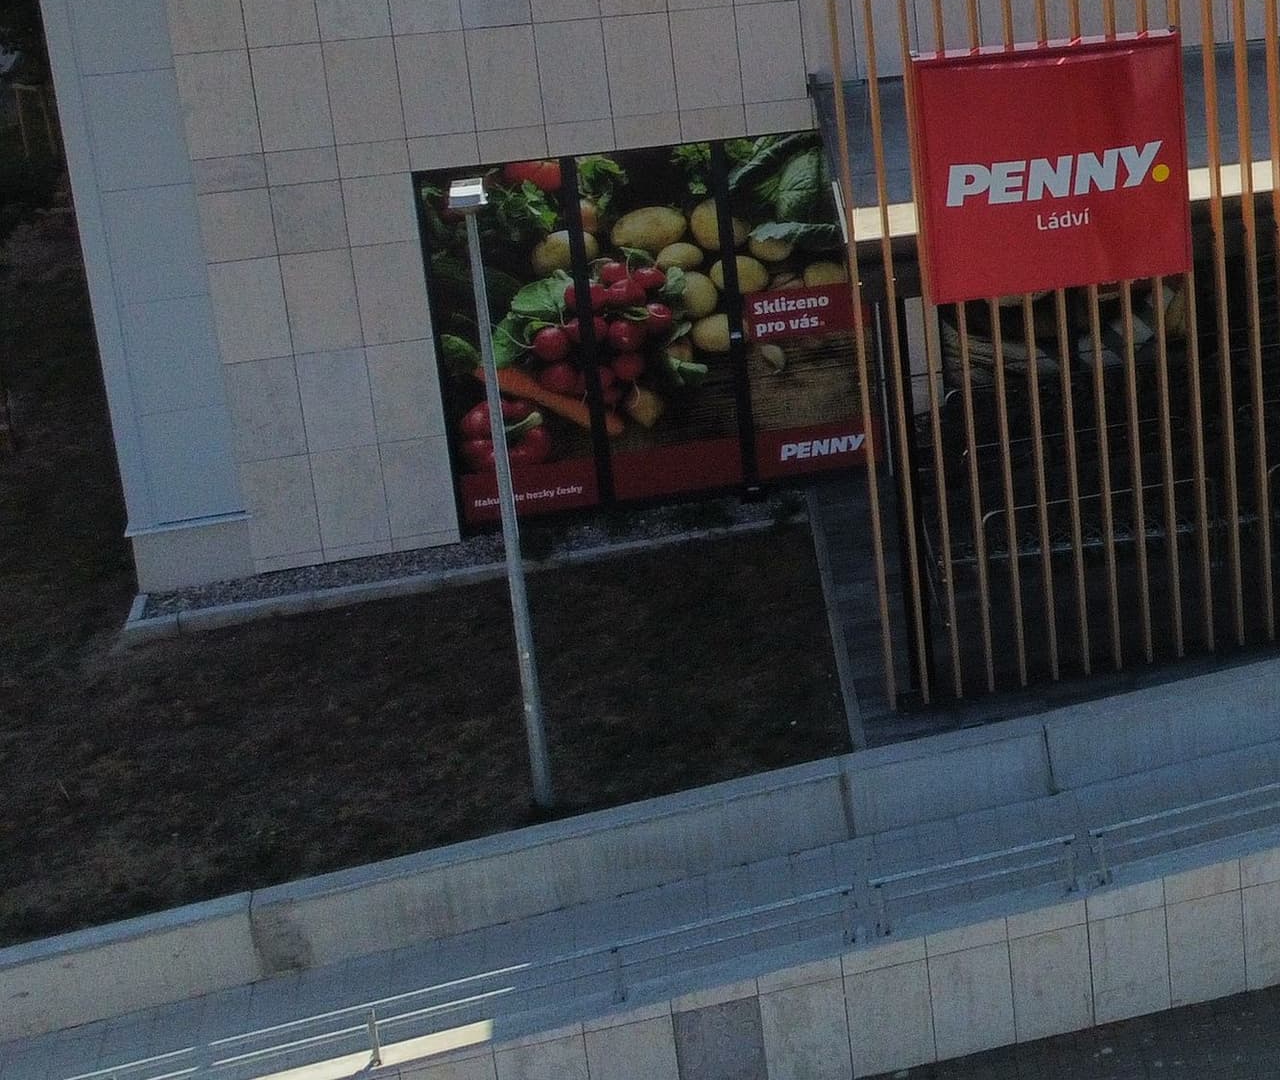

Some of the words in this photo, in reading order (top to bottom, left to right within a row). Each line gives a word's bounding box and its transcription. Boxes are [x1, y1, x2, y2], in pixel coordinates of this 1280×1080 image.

[1037, 208, 1090, 231] Ládví
[753, 295, 829, 315] Sklizeno
[756, 322, 785, 337] pro
[474, 494, 525, 508] Nakute
